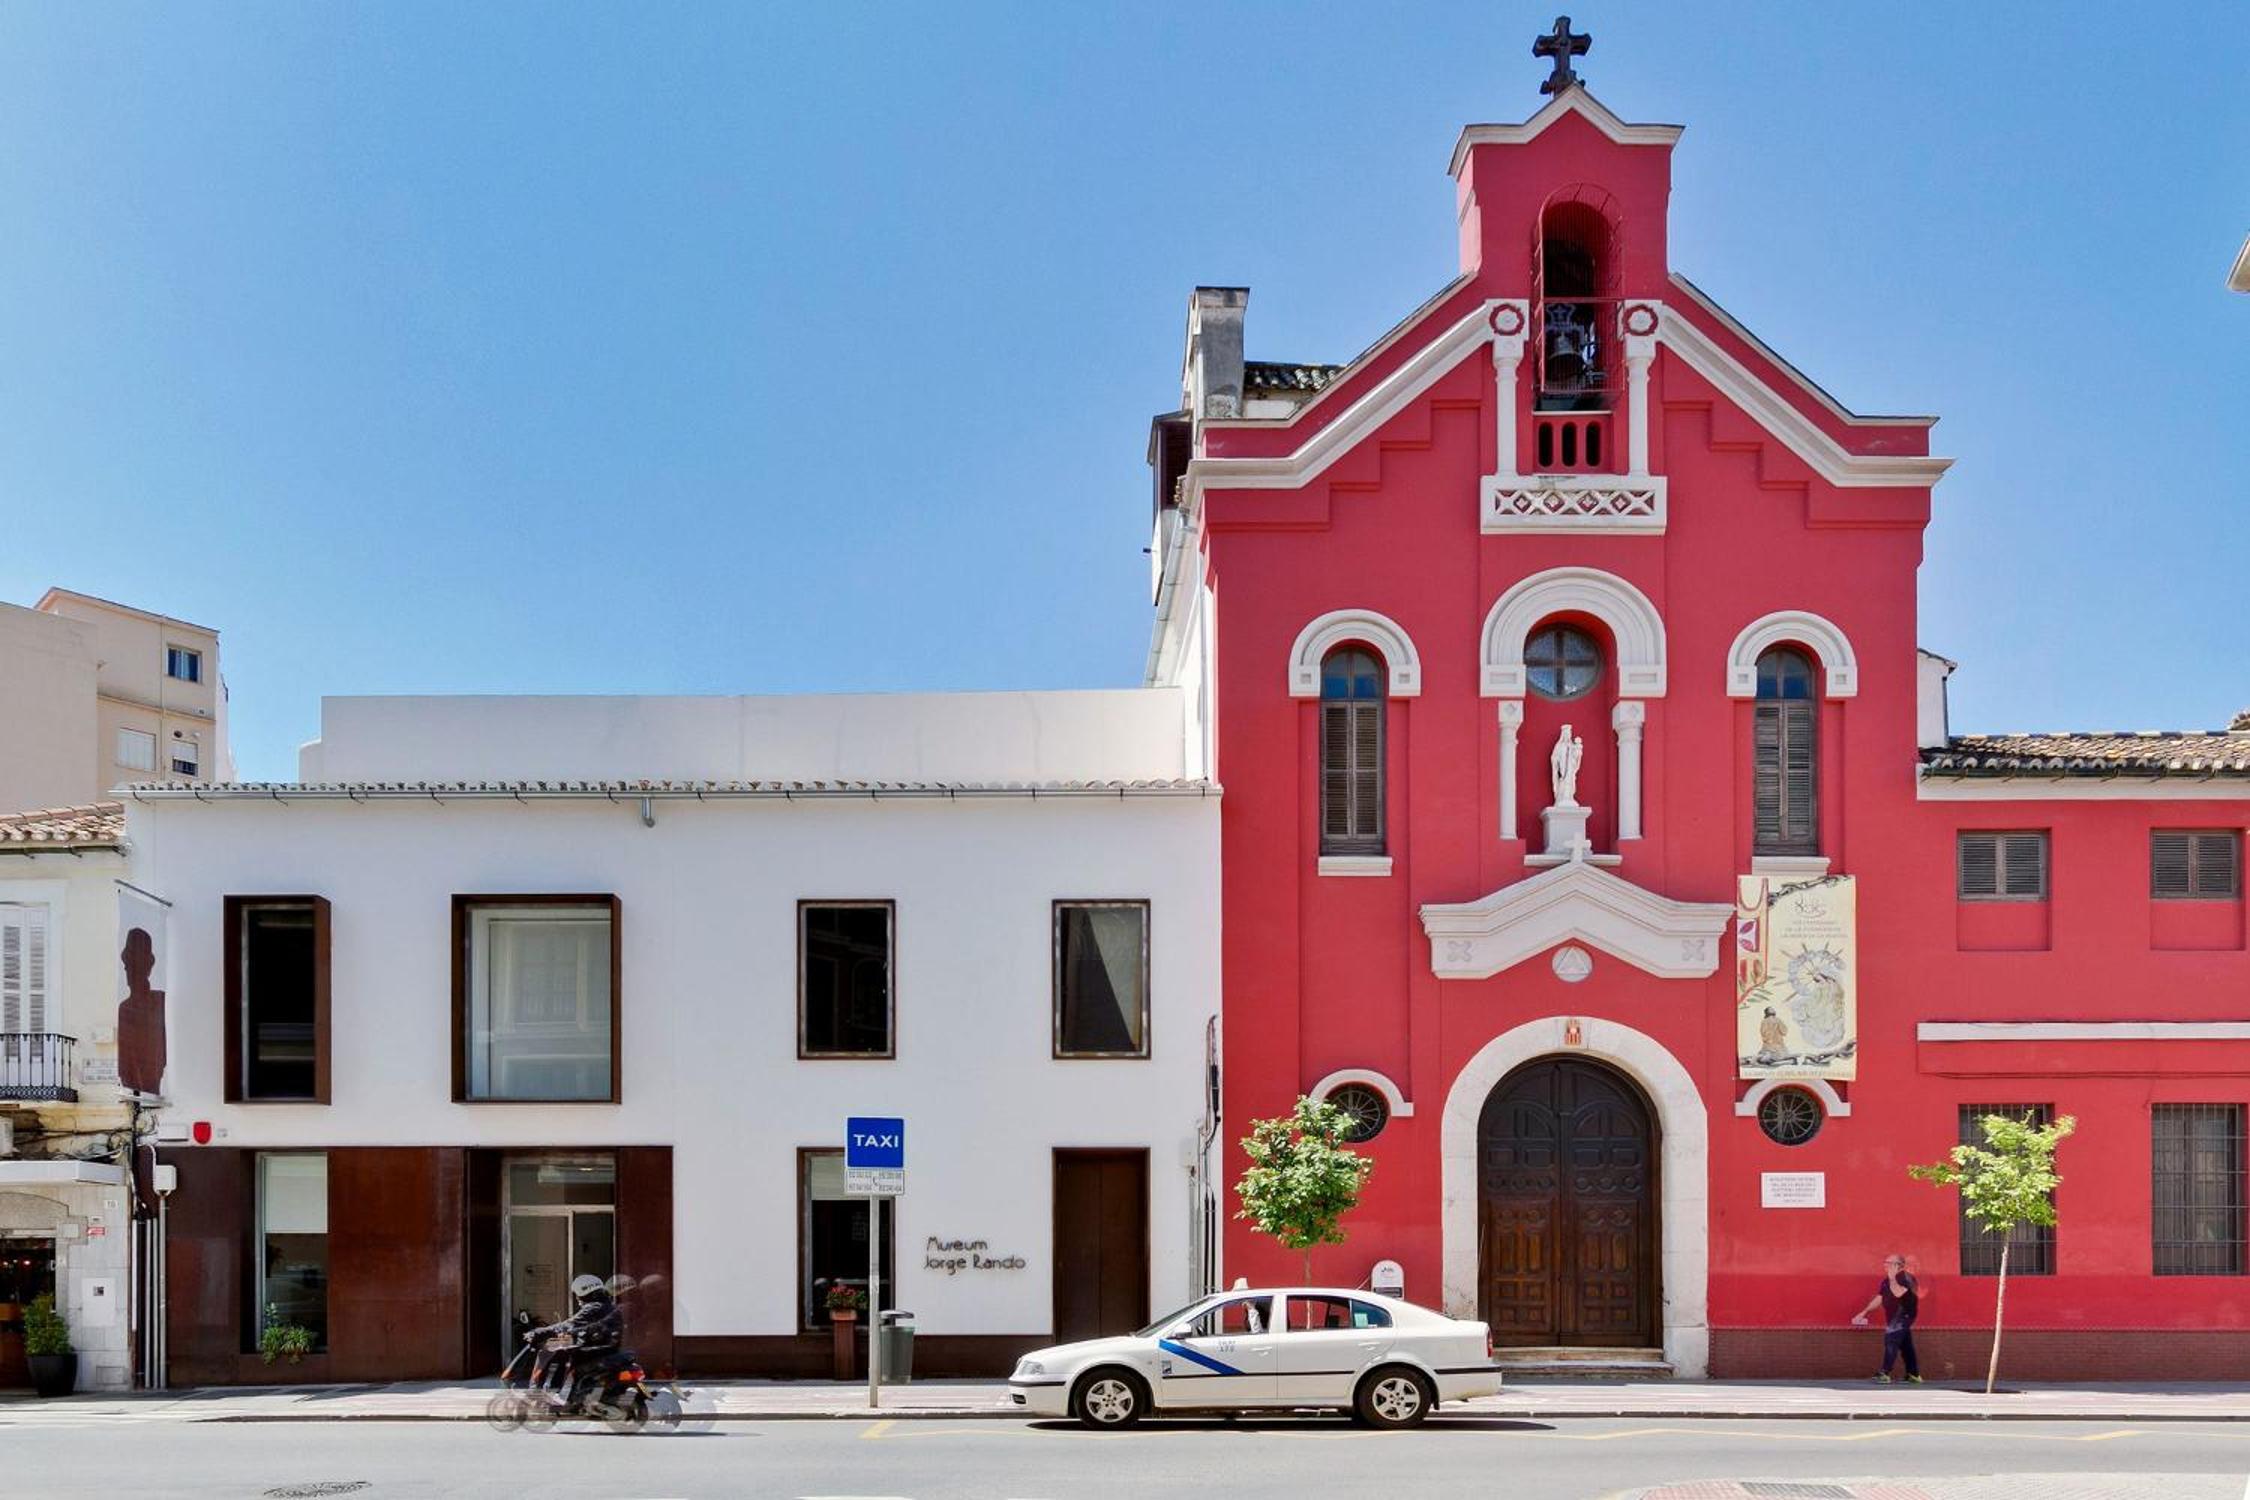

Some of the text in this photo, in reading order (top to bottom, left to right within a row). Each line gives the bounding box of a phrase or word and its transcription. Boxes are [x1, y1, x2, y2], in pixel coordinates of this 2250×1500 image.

[853, 1133, 899, 1148] TAXI
[926, 1236, 988, 1252] Museum
[924, 1253, 1026, 1276] Jorge Rando
